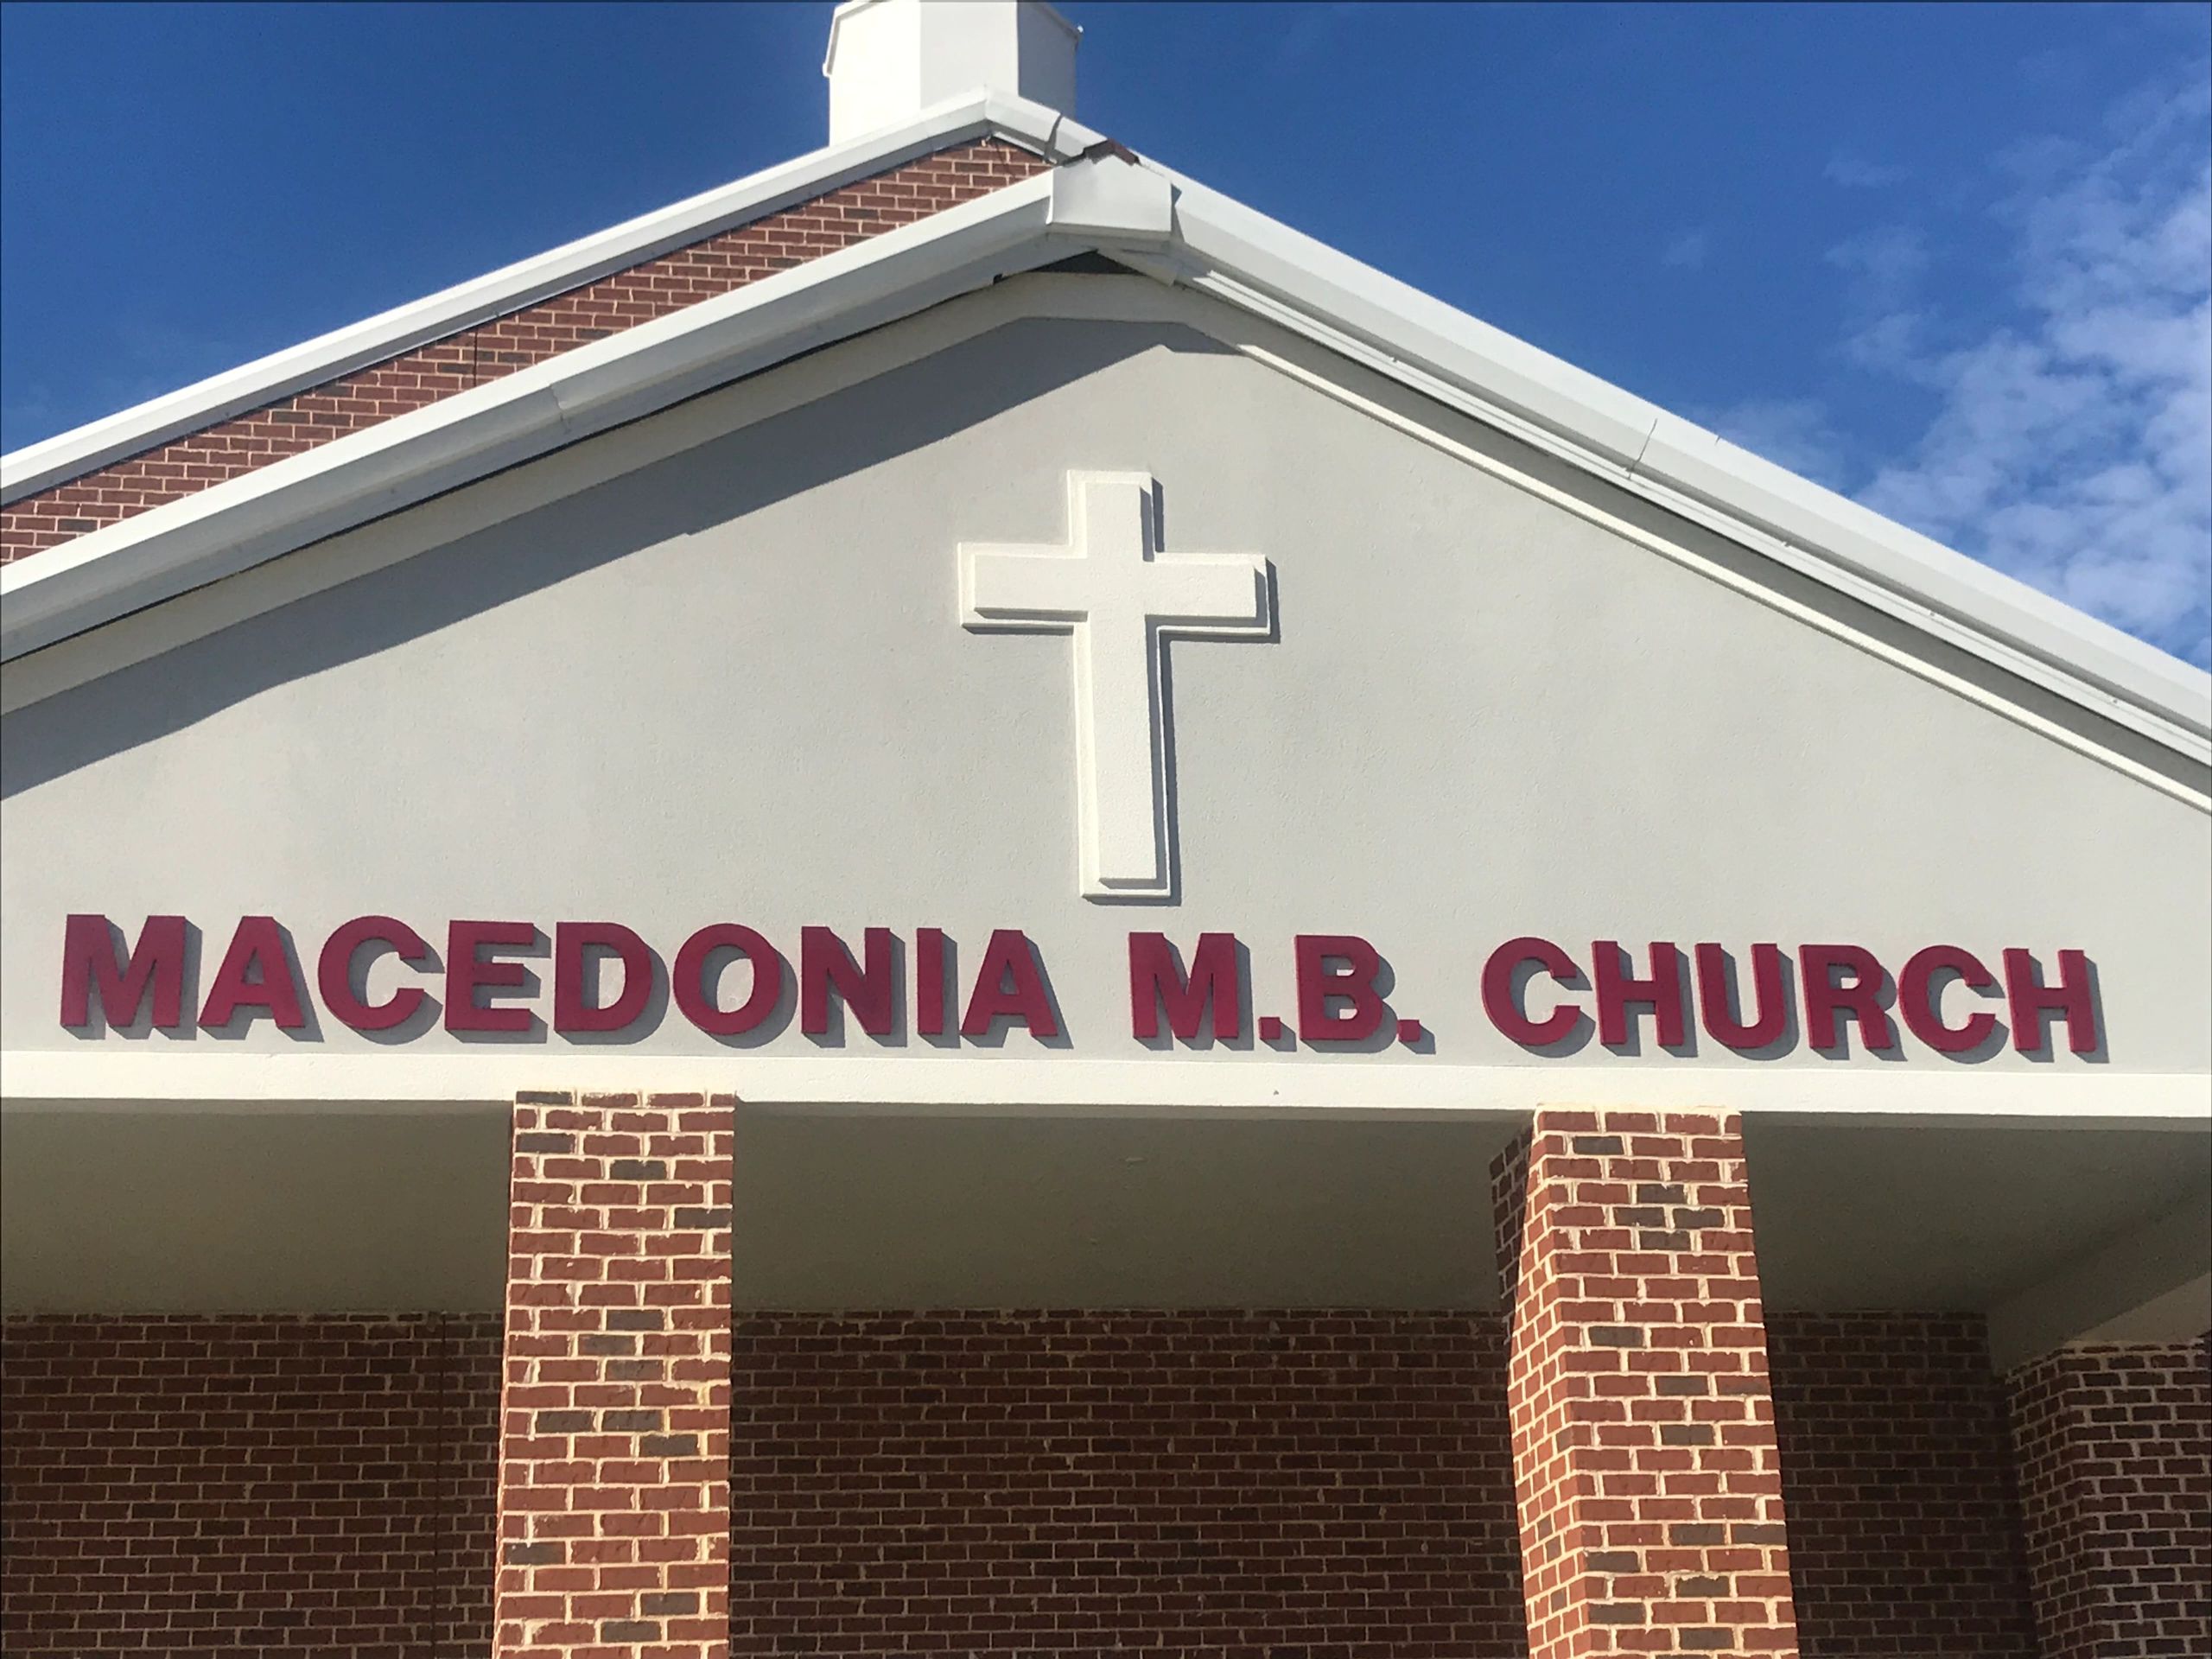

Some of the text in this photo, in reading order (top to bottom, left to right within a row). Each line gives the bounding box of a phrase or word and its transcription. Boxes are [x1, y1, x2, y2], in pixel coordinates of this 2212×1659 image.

[60, 913, 2098, 1053] MACEDONIA M.B. CHURCH
